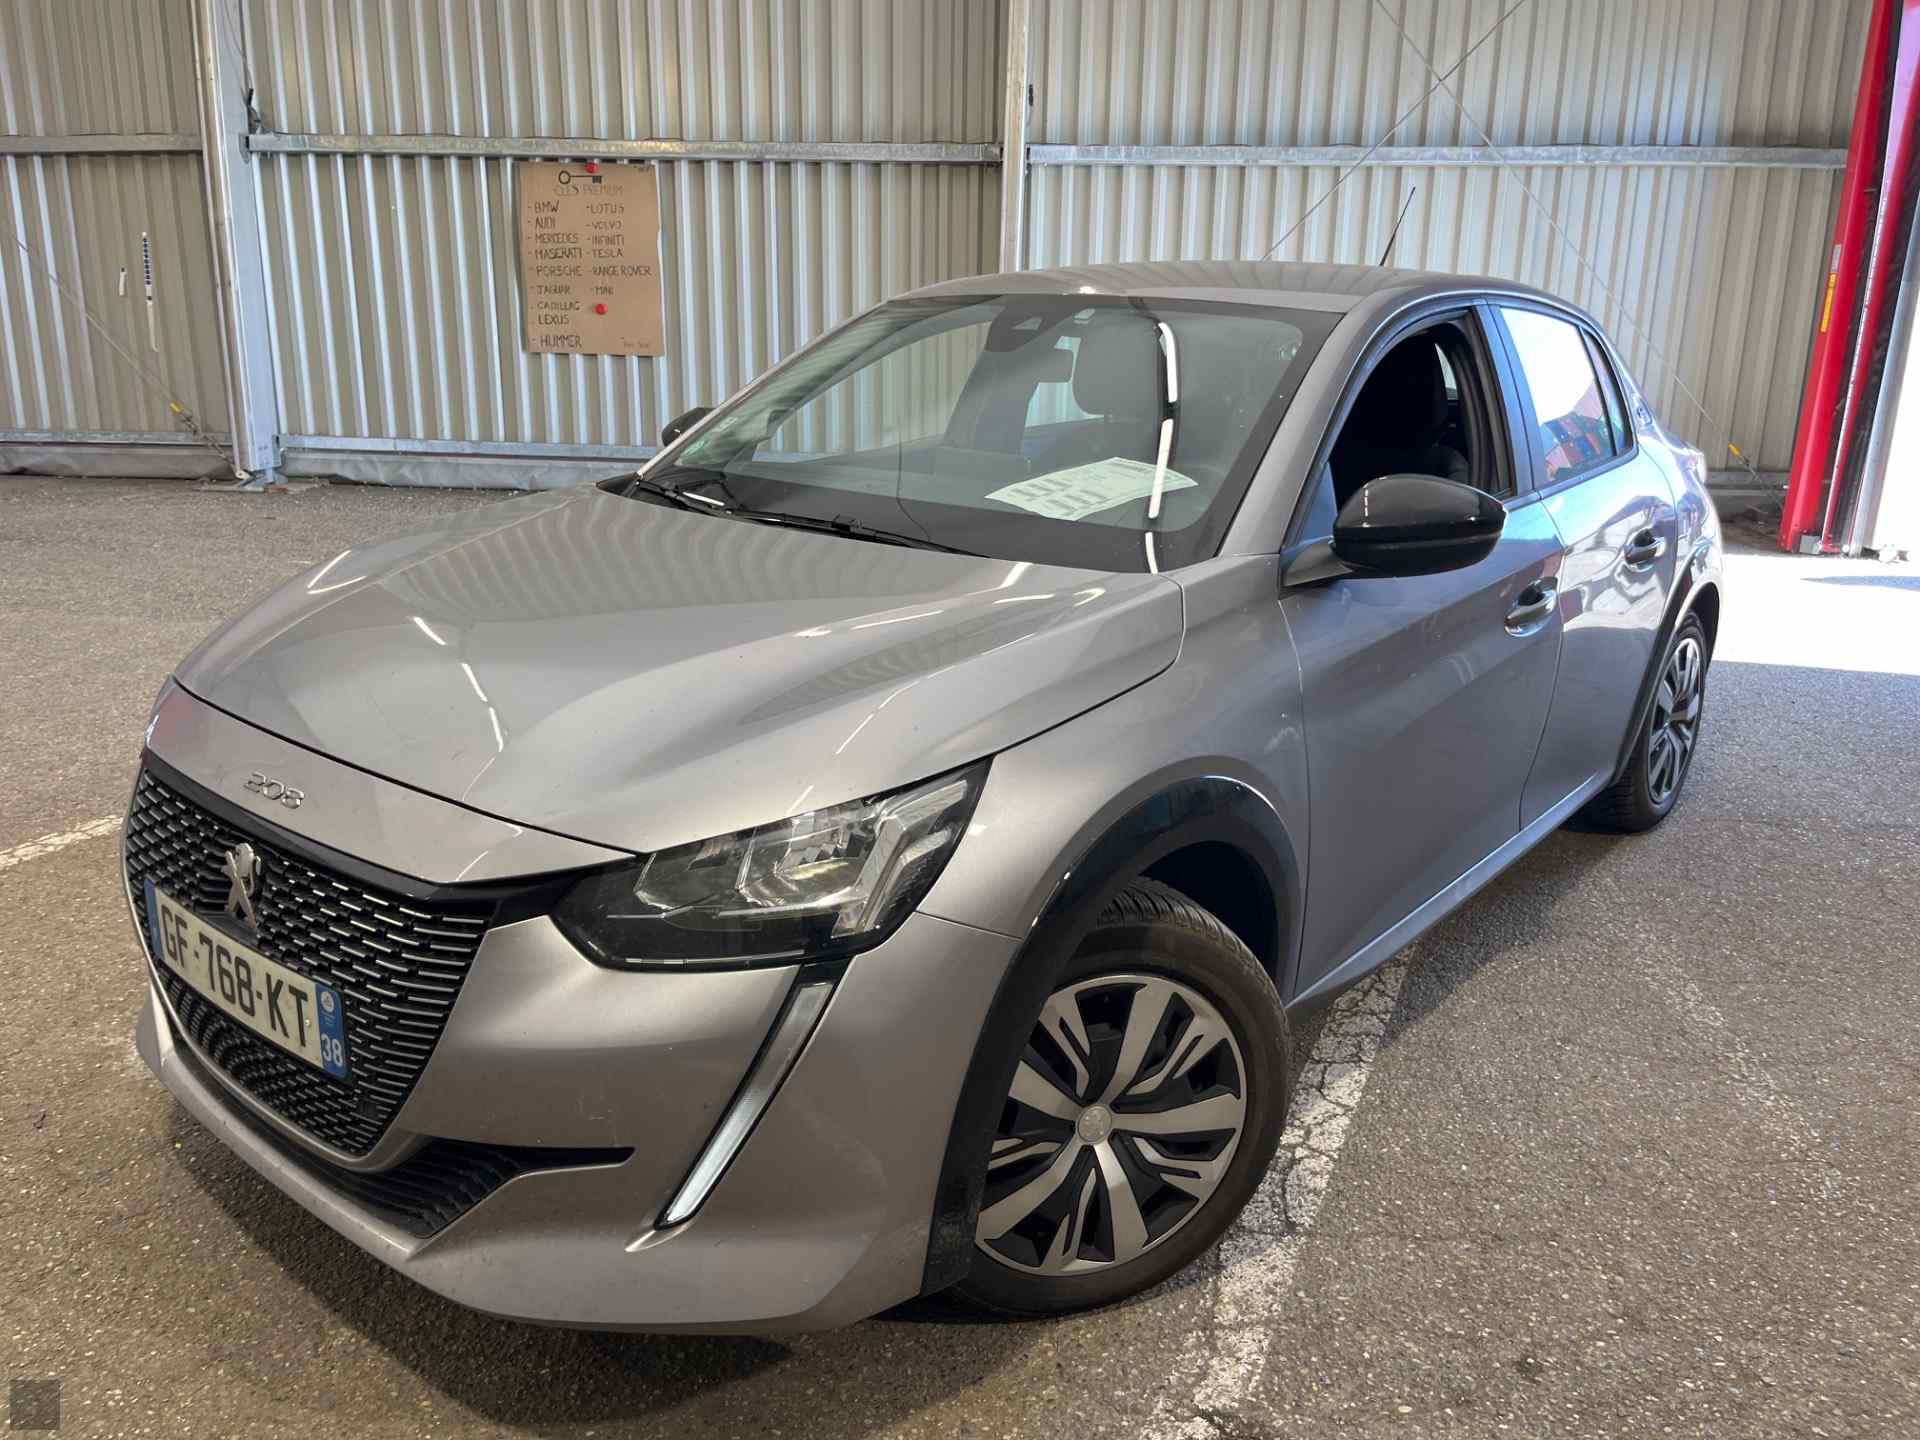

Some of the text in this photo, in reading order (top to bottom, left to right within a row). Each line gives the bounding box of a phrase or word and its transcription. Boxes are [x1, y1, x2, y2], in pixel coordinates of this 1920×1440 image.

[535, 200, 559, 213] BMW
[590, 202, 624, 214] LOTUS
[538, 314, 570, 325] LEXUS
[540, 335, 582, 348] HUMMER
[243, 771, 305, 810] 208
[161, 904, 309, 1048] GF-768-KT
[320, 1033, 343, 1067] 38
